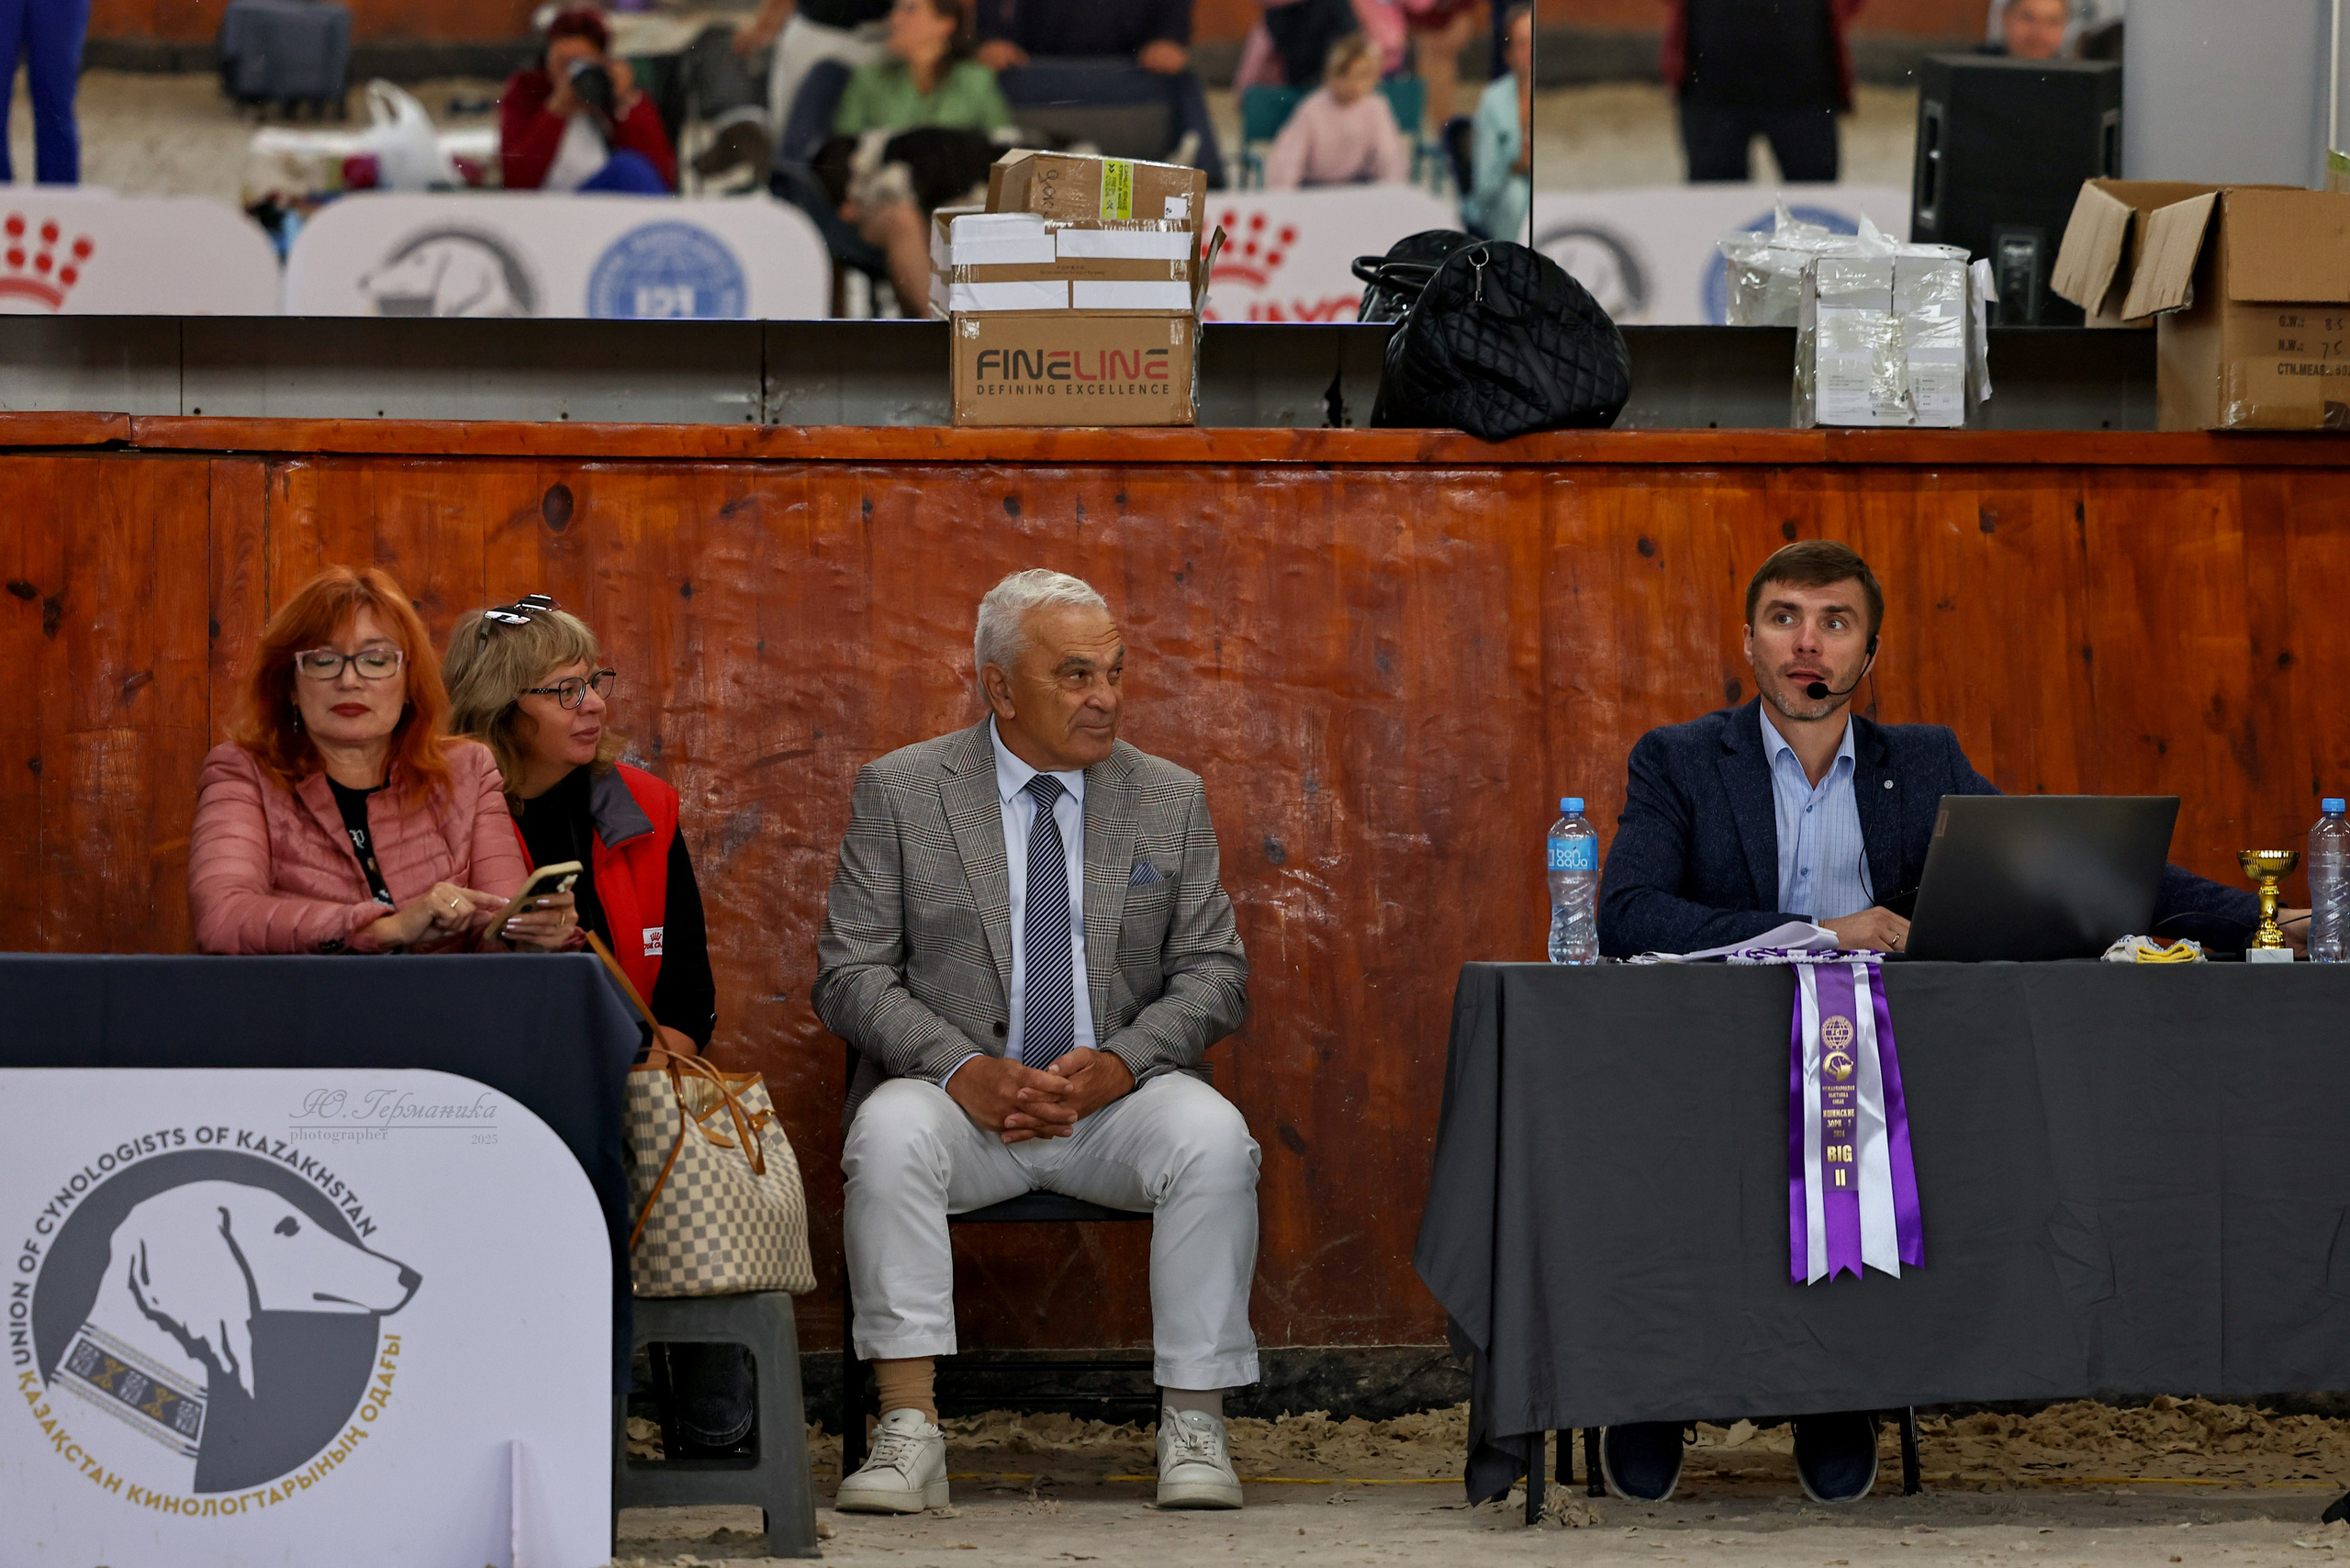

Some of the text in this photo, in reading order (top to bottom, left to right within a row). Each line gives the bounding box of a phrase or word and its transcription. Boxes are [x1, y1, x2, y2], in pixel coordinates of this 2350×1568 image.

[977, 348, 1169, 381] FINELINE
[977, 384, 1169, 396] DEFINING EXCELLENCE
[1827, 1145, 1852, 1163] BIG
[9, 1126, 377, 1366] UNION OF CYNOLOGISTS OF KAZAKHSTAN
[18, 1334, 401, 1517] ҚАЗАҚСТАН КИНОЛОГТАРЫНЫҢ ОДАҒЫ
